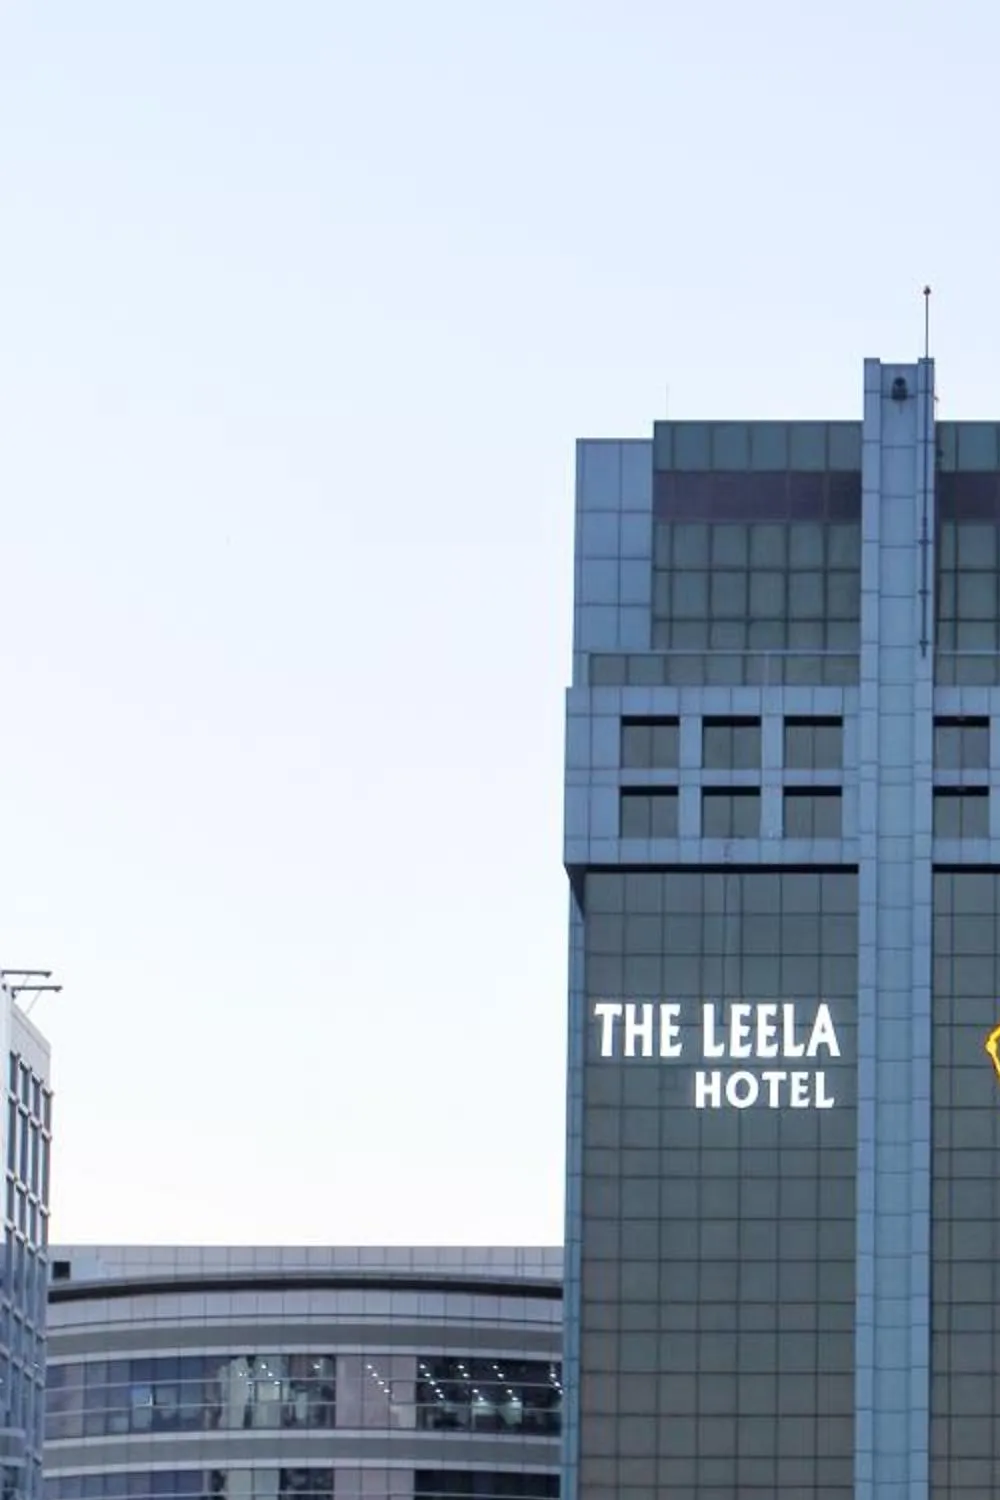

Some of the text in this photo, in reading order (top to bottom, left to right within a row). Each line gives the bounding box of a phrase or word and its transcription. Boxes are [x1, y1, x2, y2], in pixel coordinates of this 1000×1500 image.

[594, 1003, 841, 1058] THE LEELA
[695, 1071, 835, 1109] HOTEL
